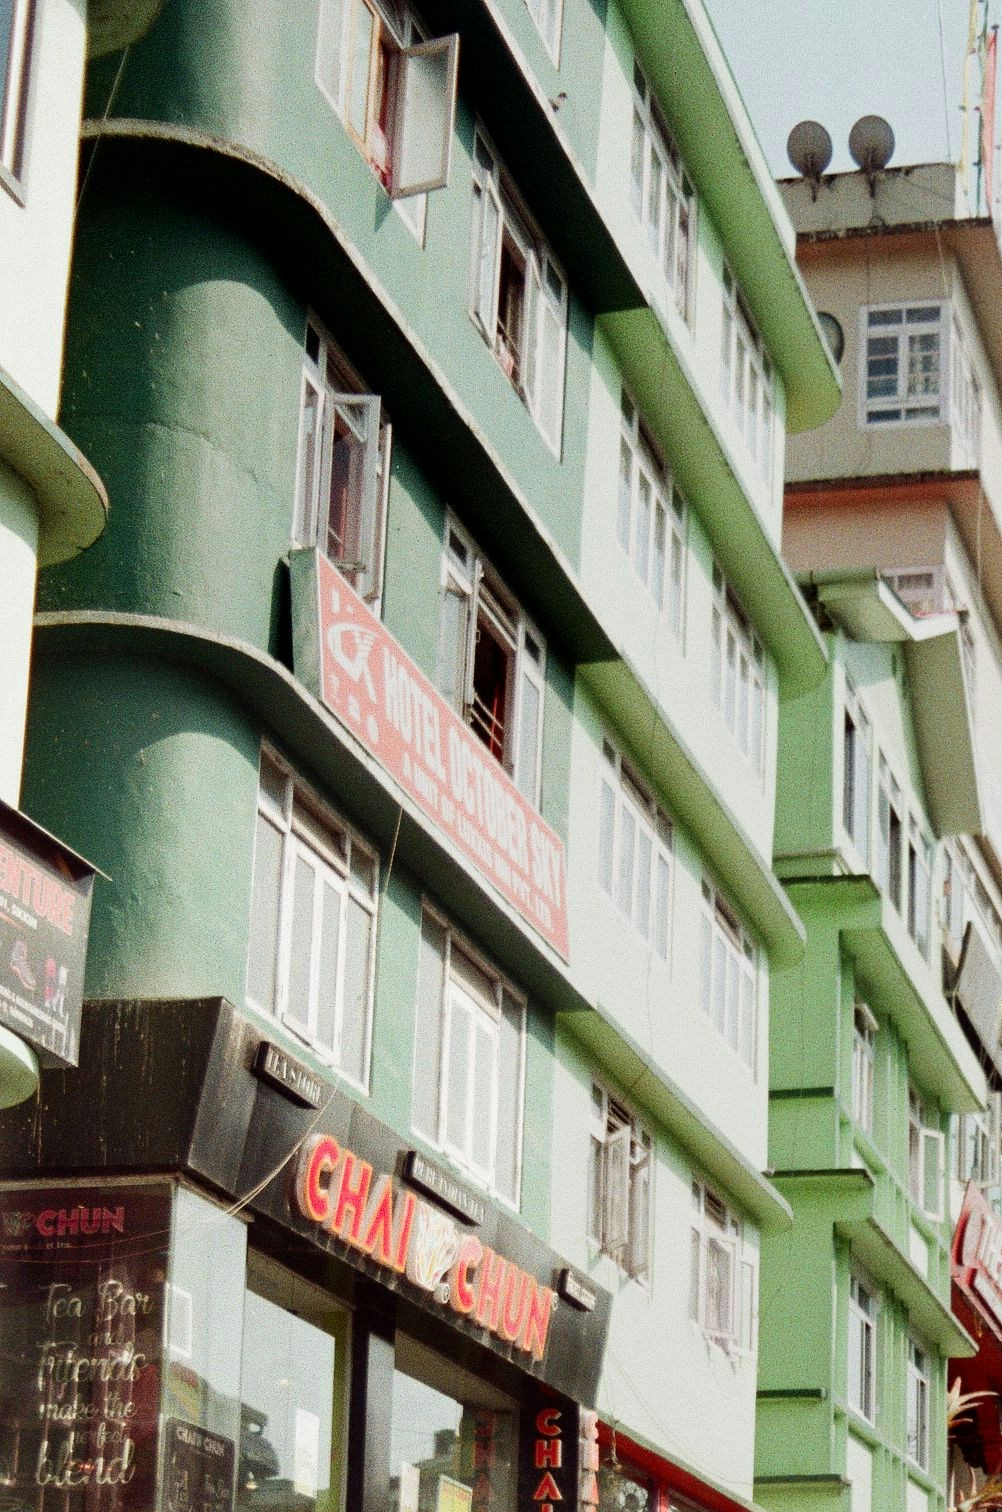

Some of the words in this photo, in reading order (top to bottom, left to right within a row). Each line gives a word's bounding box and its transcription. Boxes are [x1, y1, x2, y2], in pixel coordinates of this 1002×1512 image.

[383, 643, 446, 786] HOTEL
[448, 722, 529, 878] OCTOBER
[530, 818, 562, 912] SKY
[36, 1206, 125, 1237] CHUN
[299, 1134, 417, 1273] CHAI
[451, 1236, 553, 1361] CHUN
[43, 1282, 82, 1321] Tea
